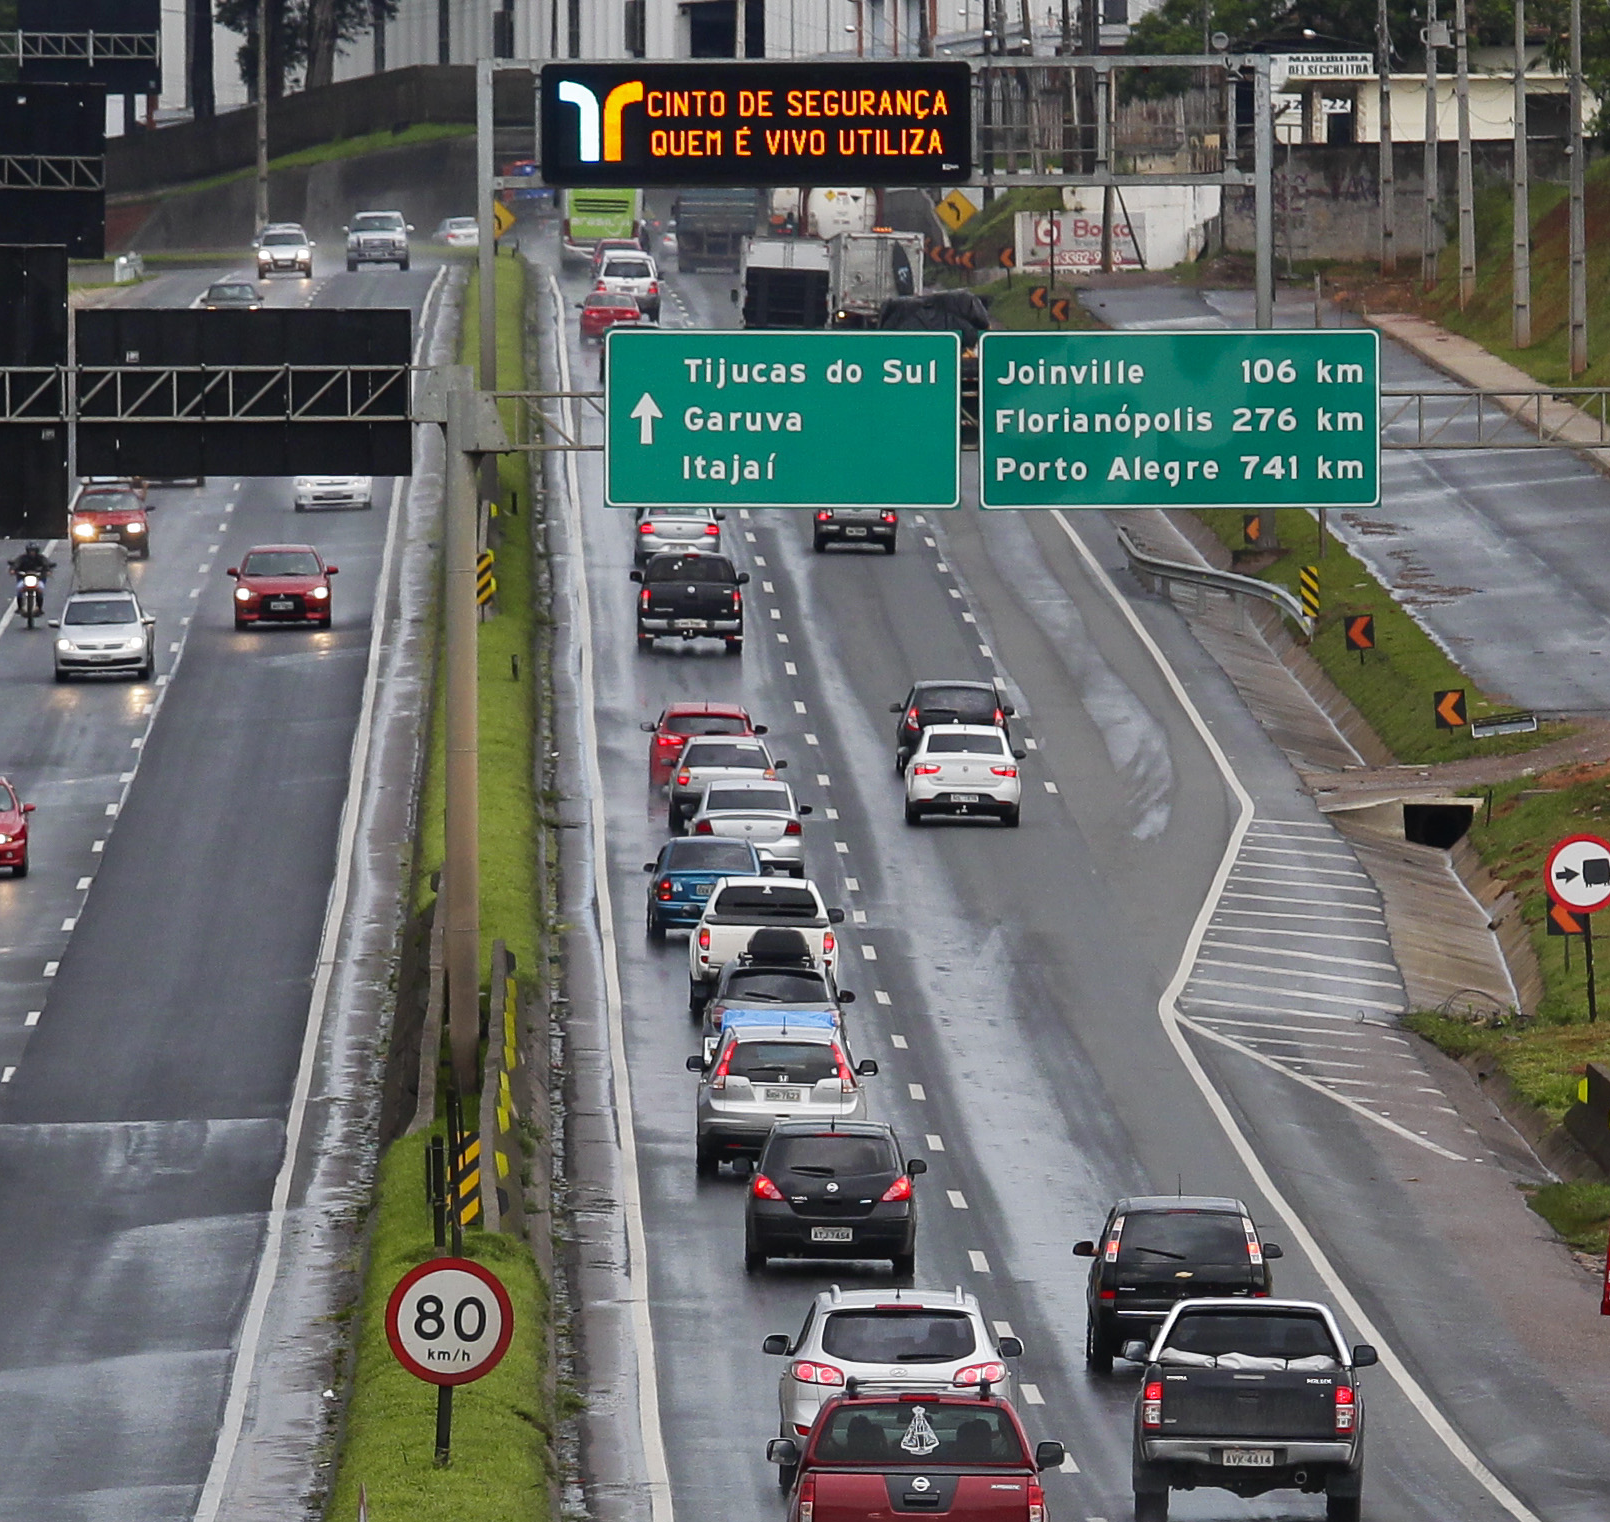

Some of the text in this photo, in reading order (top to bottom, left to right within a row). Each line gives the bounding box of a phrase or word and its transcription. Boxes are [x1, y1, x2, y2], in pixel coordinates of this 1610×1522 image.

[647, 89, 948, 120] CINTO DE SEGURANÇA
[651, 126, 943, 157] QUEM É VIVO UTILIZA
[684, 357, 936, 389] Tijucas do Sul
[997, 358, 1363, 385] Joinville 106 km
[684, 406, 802, 432] Garuva
[996, 403, 1363, 439] Florianópolis 276 km
[683, 452, 777, 485] Itajaí
[996, 455, 1363, 487] Porto Alegre 741 km
[414, 1294, 487, 1343] 80
[427, 1348, 471, 1362] km/h
